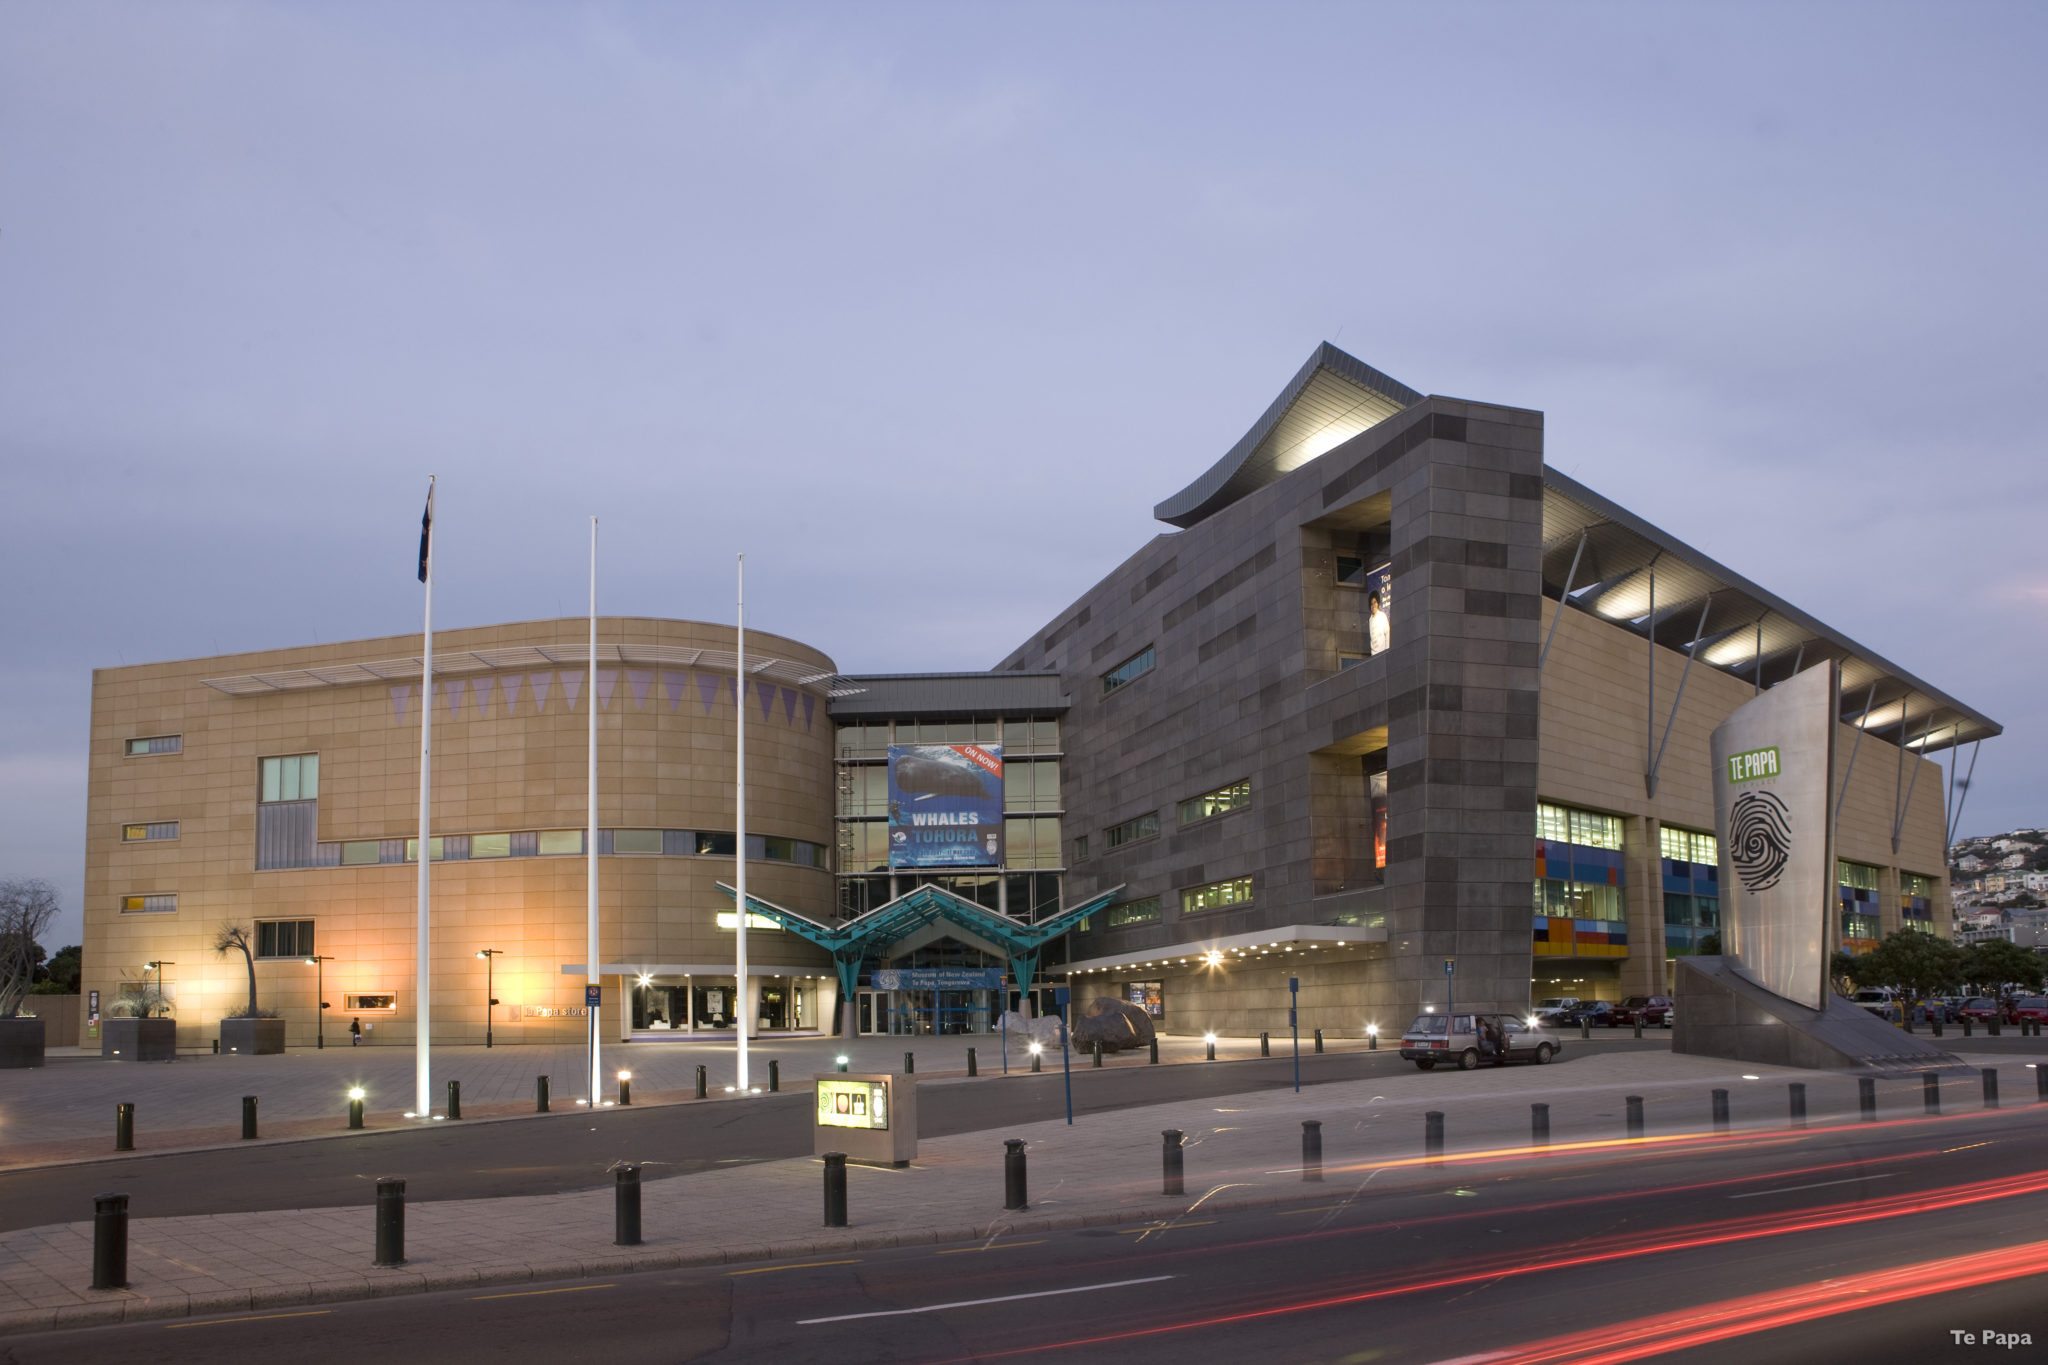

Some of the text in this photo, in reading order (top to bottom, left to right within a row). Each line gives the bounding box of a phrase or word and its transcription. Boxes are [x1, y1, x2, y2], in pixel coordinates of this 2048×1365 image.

[964, 746, 999, 771] ON NOW!
[1730, 749, 1777, 780] TE PAPA
[912, 811, 979, 827] WHALES
[961, 970, 985, 978] Zealand
[536, 1006, 559, 1018] Papa
[562, 1006, 587, 1016] store
